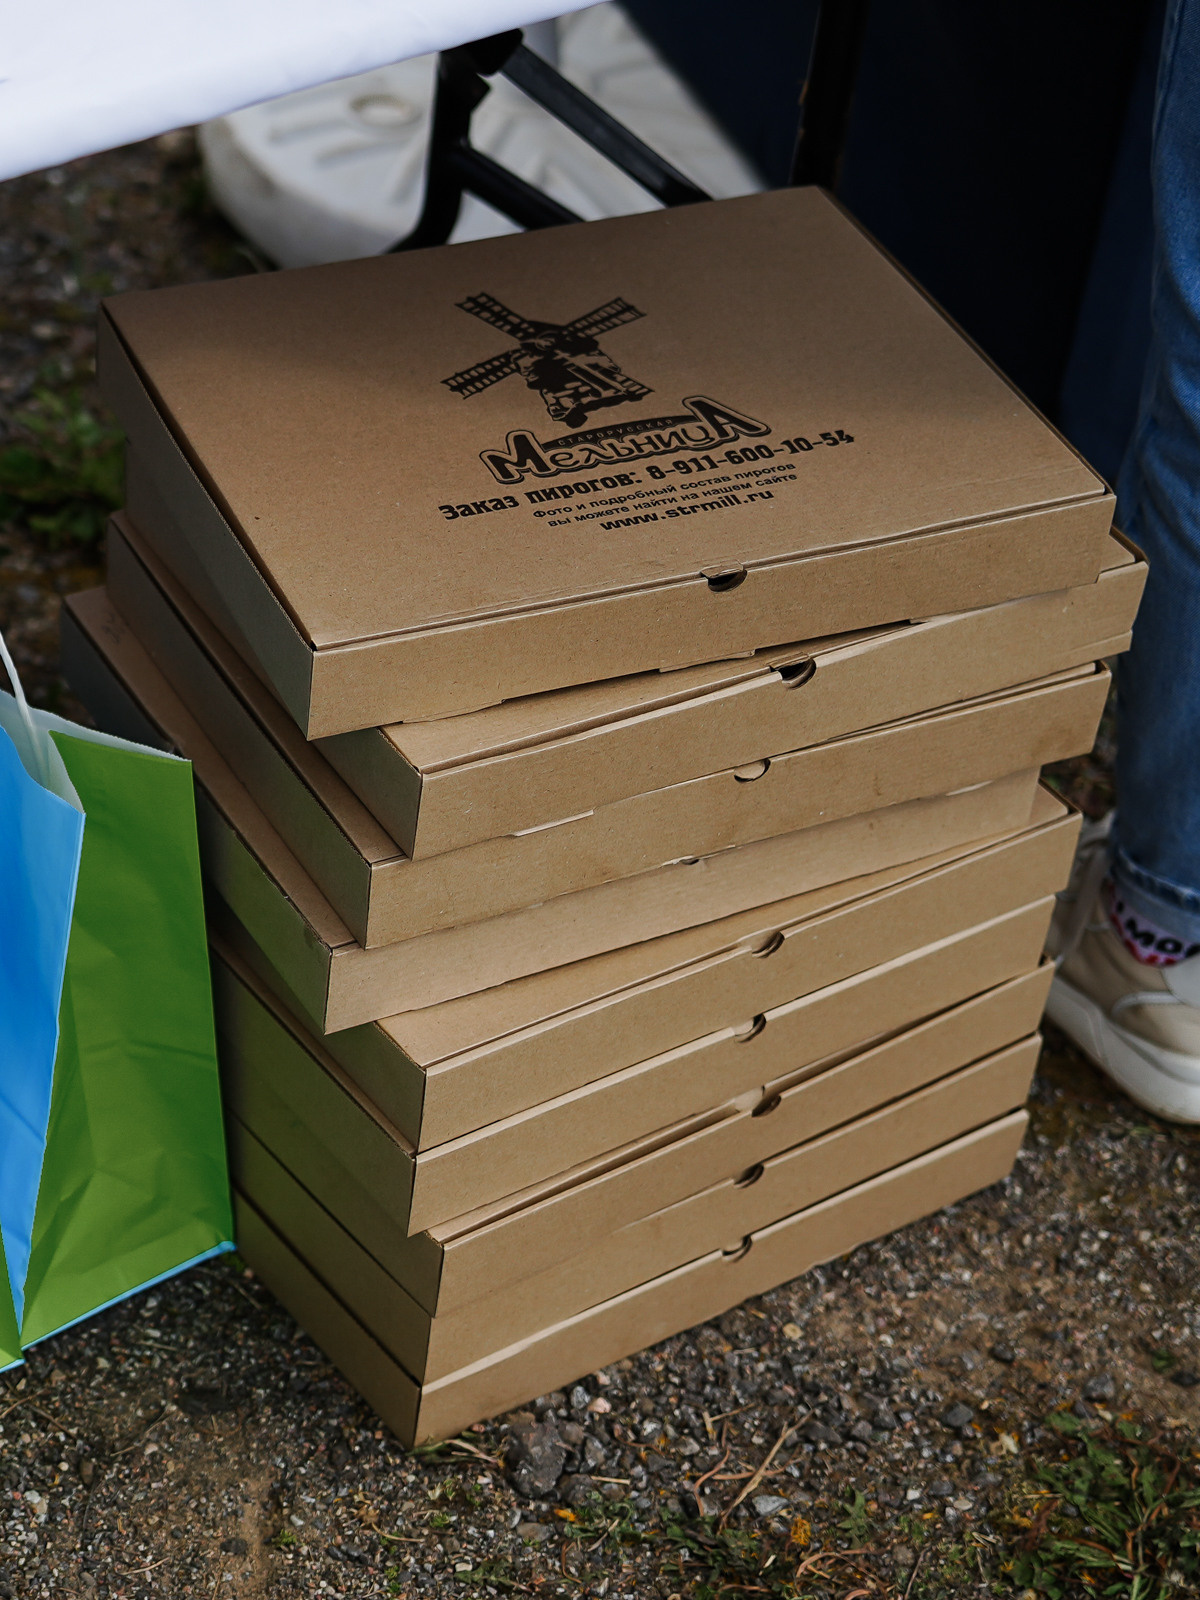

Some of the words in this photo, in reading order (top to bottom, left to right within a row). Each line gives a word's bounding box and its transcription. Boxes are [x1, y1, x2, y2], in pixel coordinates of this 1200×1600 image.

[557, 418, 674, 446] СТАРОРУССКАЯ
[438, 495, 520, 520] Заказ
[524, 472, 643, 504] пирогов:
[645, 429, 855, 480] 8-911-600-10-54
[533, 505, 573, 518] Фото
[589, 483, 678, 510] подробный
[680, 474, 732, 491] состав
[734, 463, 796, 482] пирогов
[548, 516, 572, 528] вы
[574, 506, 630, 522] можете
[634, 495, 679, 512] найти
[681, 491, 700, 502] на
[701, 482, 753, 498] нашем
[755, 472, 798, 487] сайте
[599, 489, 775, 531] www.strmill.ru
